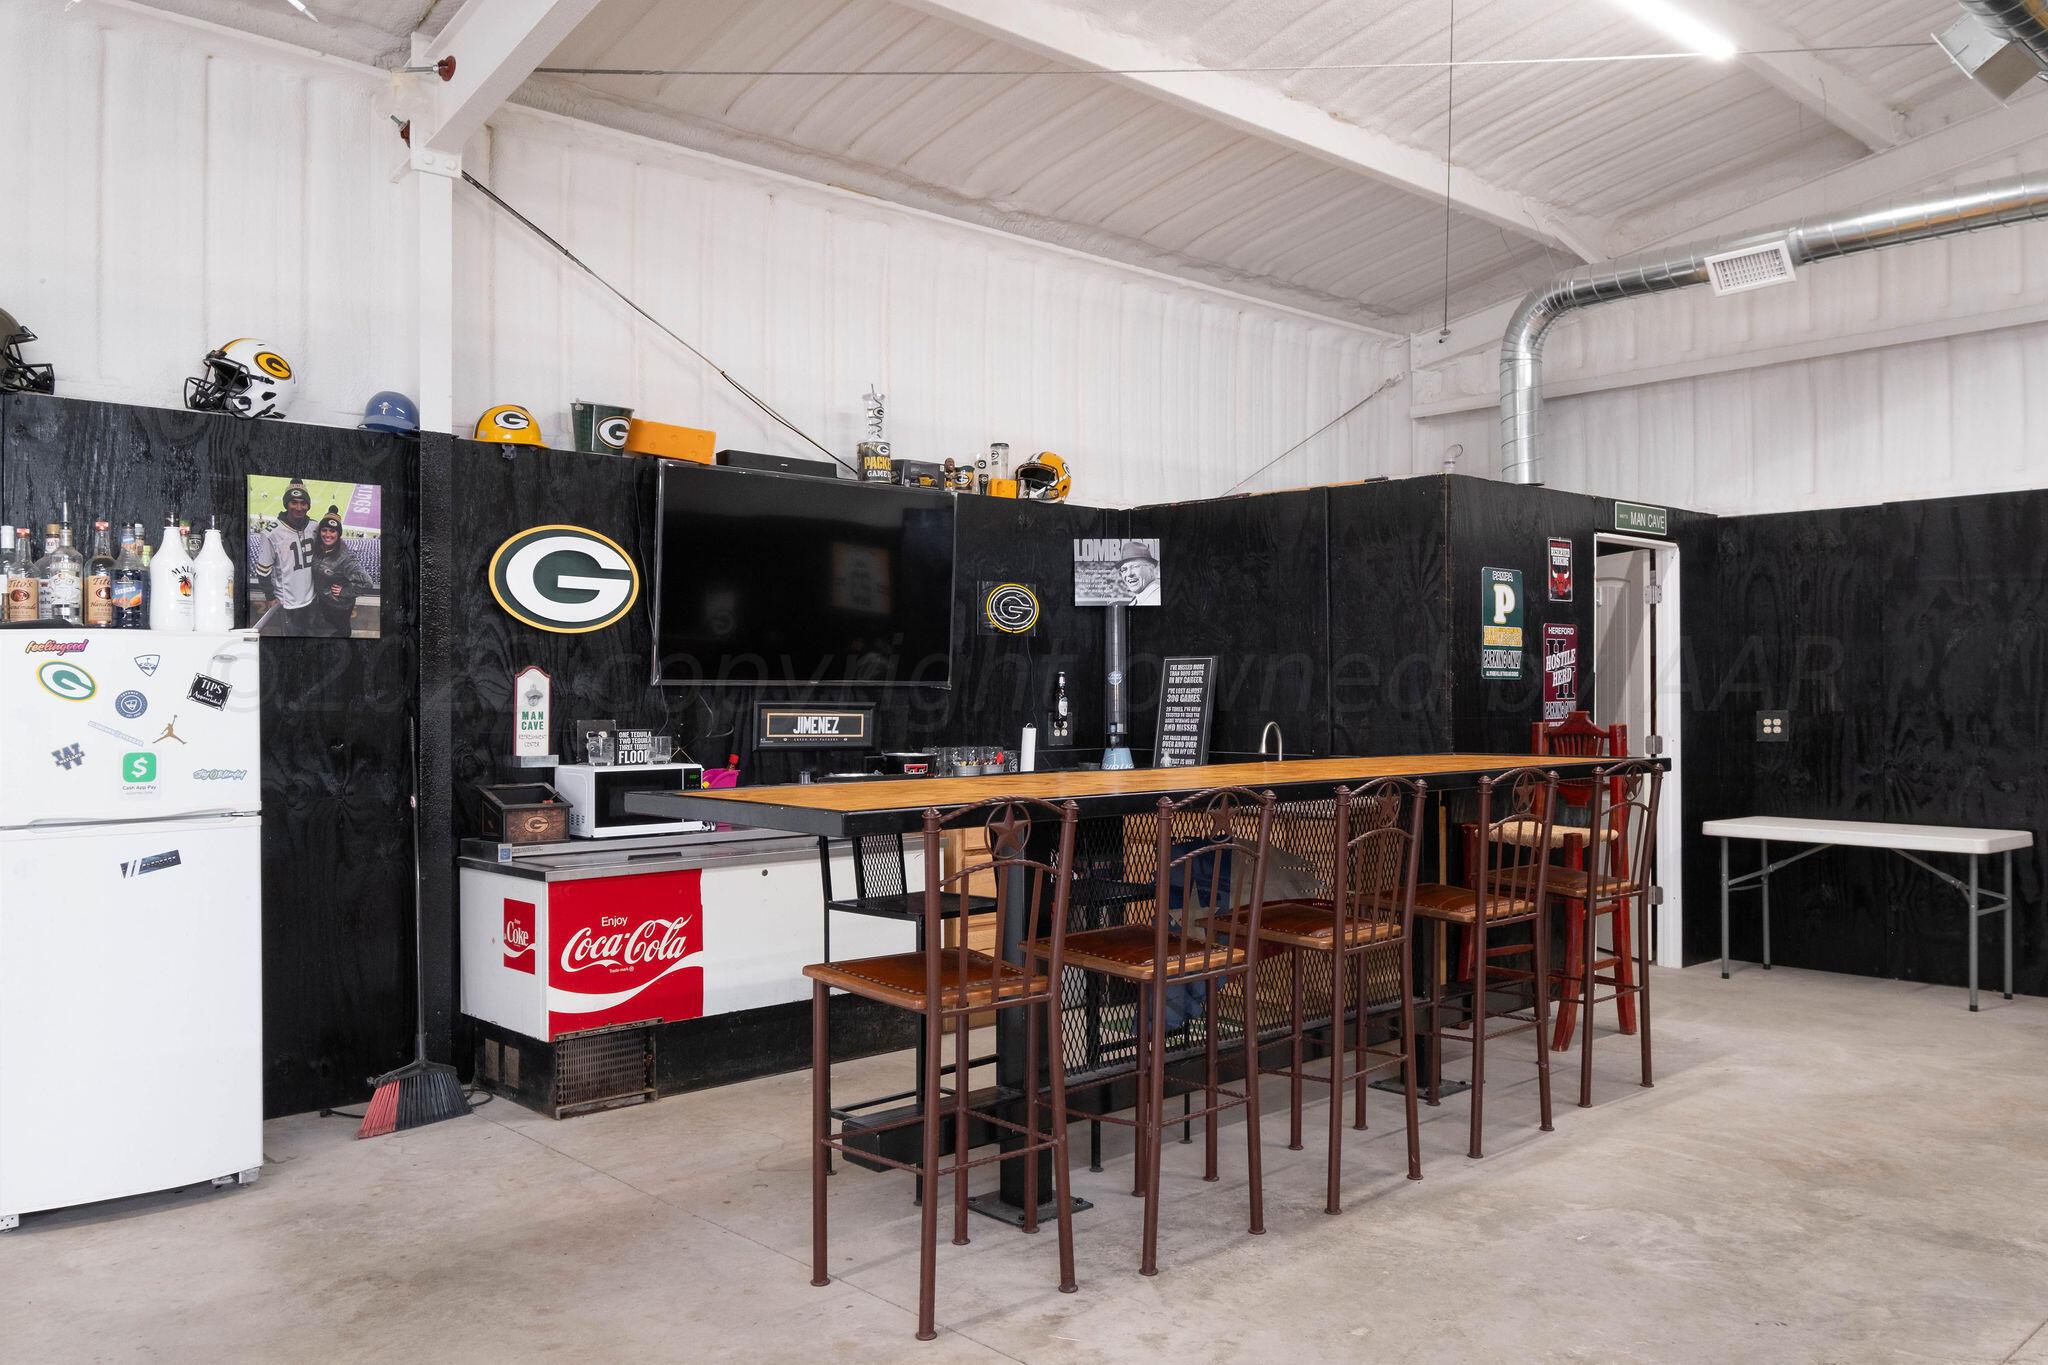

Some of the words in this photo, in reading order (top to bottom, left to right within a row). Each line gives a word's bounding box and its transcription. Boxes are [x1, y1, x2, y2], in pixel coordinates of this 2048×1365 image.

[1630, 511, 1646, 527] MAN
[1648, 514, 1664, 530] CAVE
[505, 536, 631, 623] G
[1492, 570, 1514, 582] PAMPA
[1494, 583, 1516, 624] P
[1548, 627, 1574, 636] HEREFORD
[1546, 648, 1576, 672] HOSTILE
[1552, 668, 1572, 686] HERD
[202, 679, 224, 694] TIPS
[522, 711, 544, 720] MAN
[522, 722, 544, 730] CAVE
[793, 716, 840, 734] JIMENEZ
[602, 916, 628, 927] Enjoy
[507, 920, 528, 946] Coke
[560, 914, 692, 972] Coca-Cola
